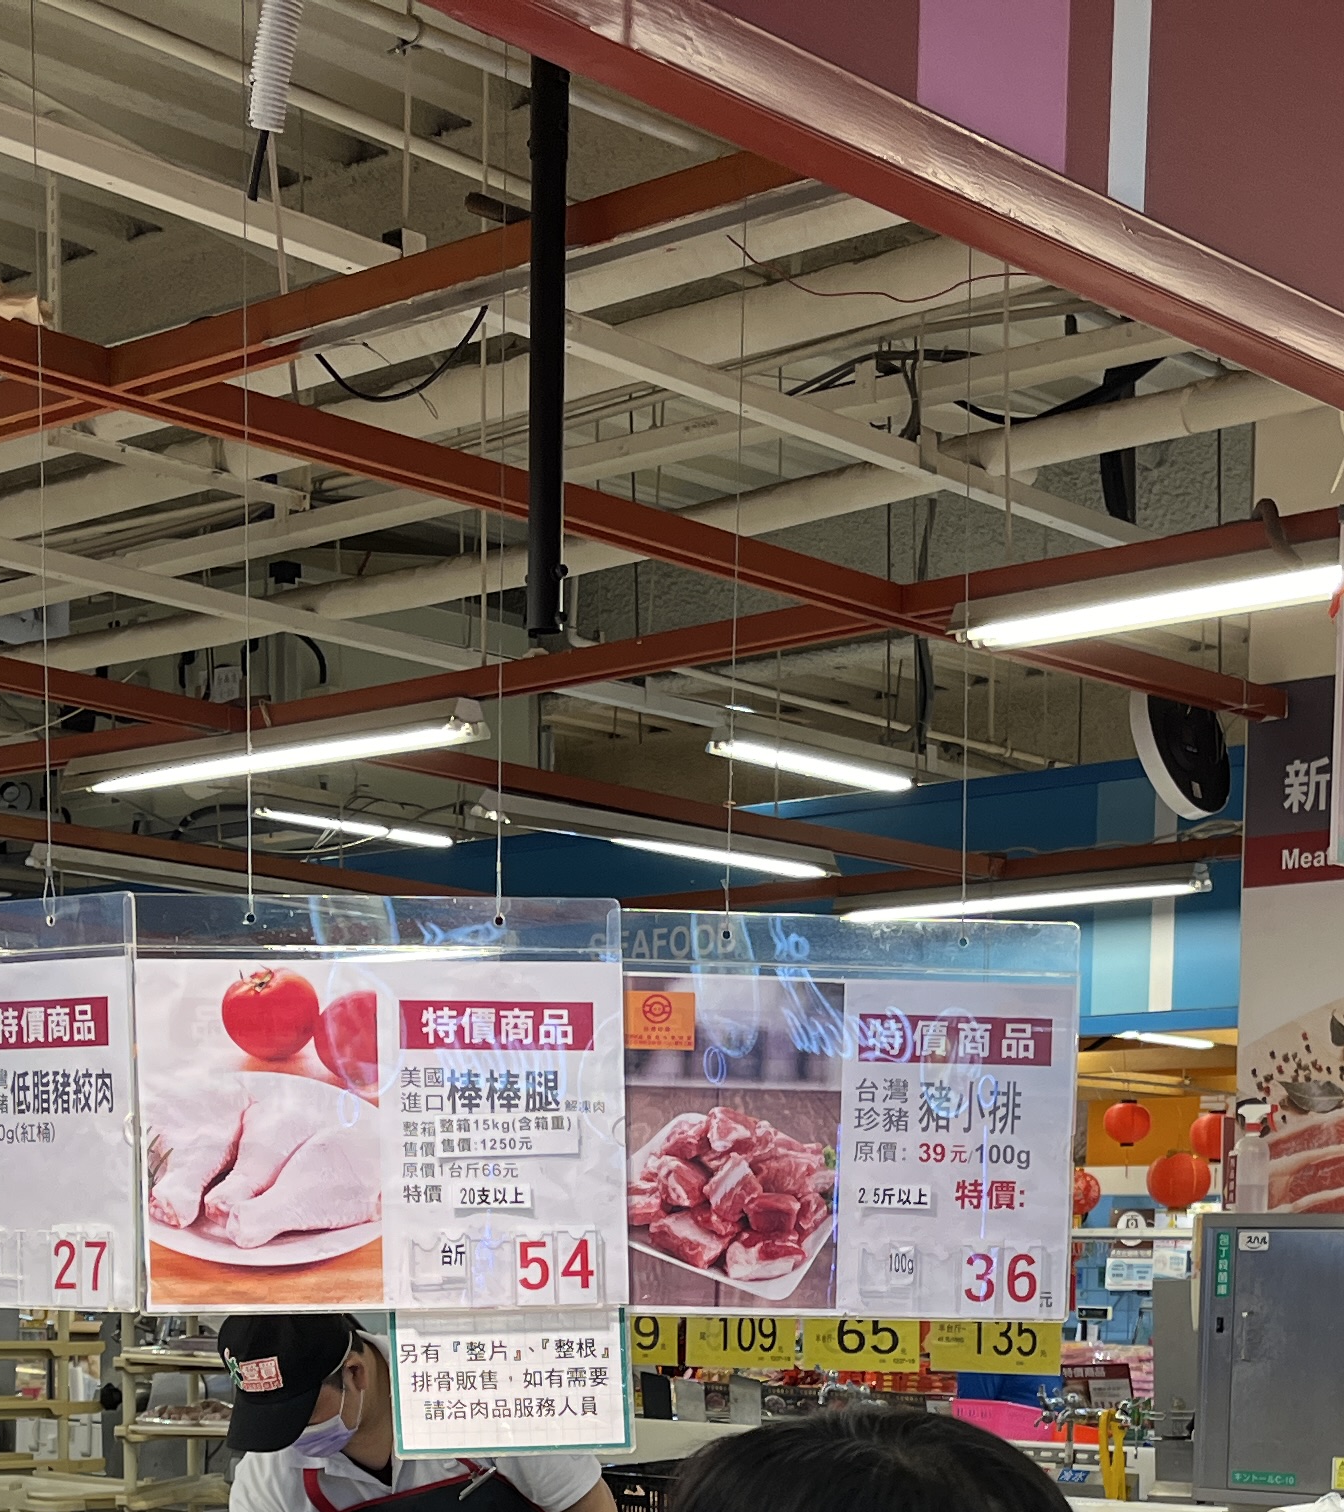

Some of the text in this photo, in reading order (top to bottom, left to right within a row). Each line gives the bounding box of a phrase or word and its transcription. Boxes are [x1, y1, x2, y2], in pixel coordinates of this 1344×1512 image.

[1283, 756, 1330, 813] 新
[420, 1006, 574, 1045] 特價商品
[867, 1017, 1036, 1060] 特價商品
[10, 1068, 115, 1115] 低脂豬絞肉
[400, 1066, 445, 1088] 美國
[446, 1068, 561, 1115] 棒棒腿
[855, 1078, 909, 1105] 台灣
[400, 1092, 445, 1114] 進口
[917, 1080, 1023, 1136] 豬小排
[439, 1115, 572, 1134] 整箱15kg(含箱重)
[854, 1107, 909, 1133] 珍豬
[441, 1136, 533, 1153] 售價:1250元
[401, 1162, 519, 1179] 原價1台斤66元
[403, 1183, 442, 1204] 特價
[459, 1187, 525, 1206] 20支以上
[955, 1179, 1026, 1211] 特價:
[53, 1239, 108, 1292] 27
[441, 1243, 465, 1267] 台斤
[518, 1239, 594, 1291] 54
[889, 1252, 915, 1275] 100g
[964, 1253, 1037, 1303] 36
[719, 1317, 777, 1352] 109
[837, 1319, 899, 1354] 65
[974, 1321, 1037, 1357] 135
[423, 1396, 598, 1421] 請洽肉品服務人員
